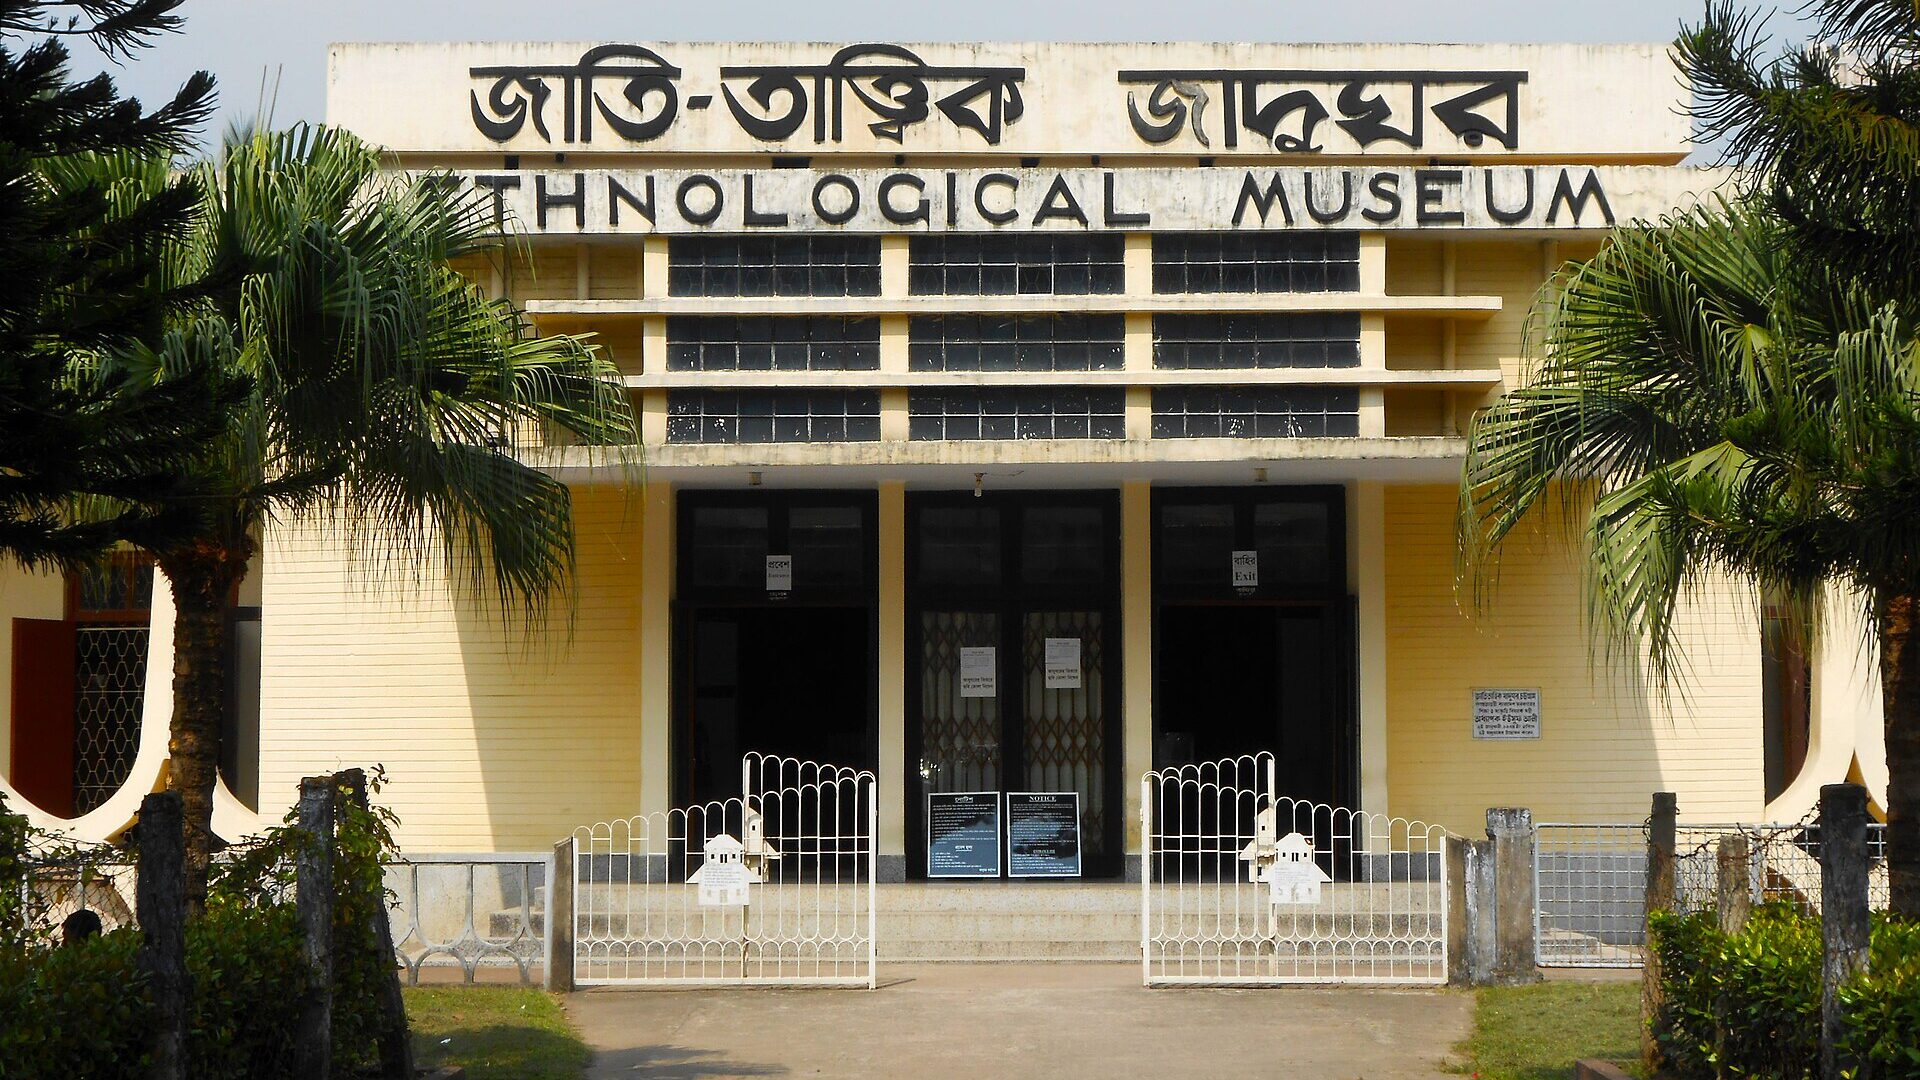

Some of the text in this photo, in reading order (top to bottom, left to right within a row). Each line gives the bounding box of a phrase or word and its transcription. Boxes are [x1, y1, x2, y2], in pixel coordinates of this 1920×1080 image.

[1118, 70, 1528, 152] জাদুঘর
[1232, 168, 1616, 229] MUSEUM
[1235, 572, 1256, 581] Exit
